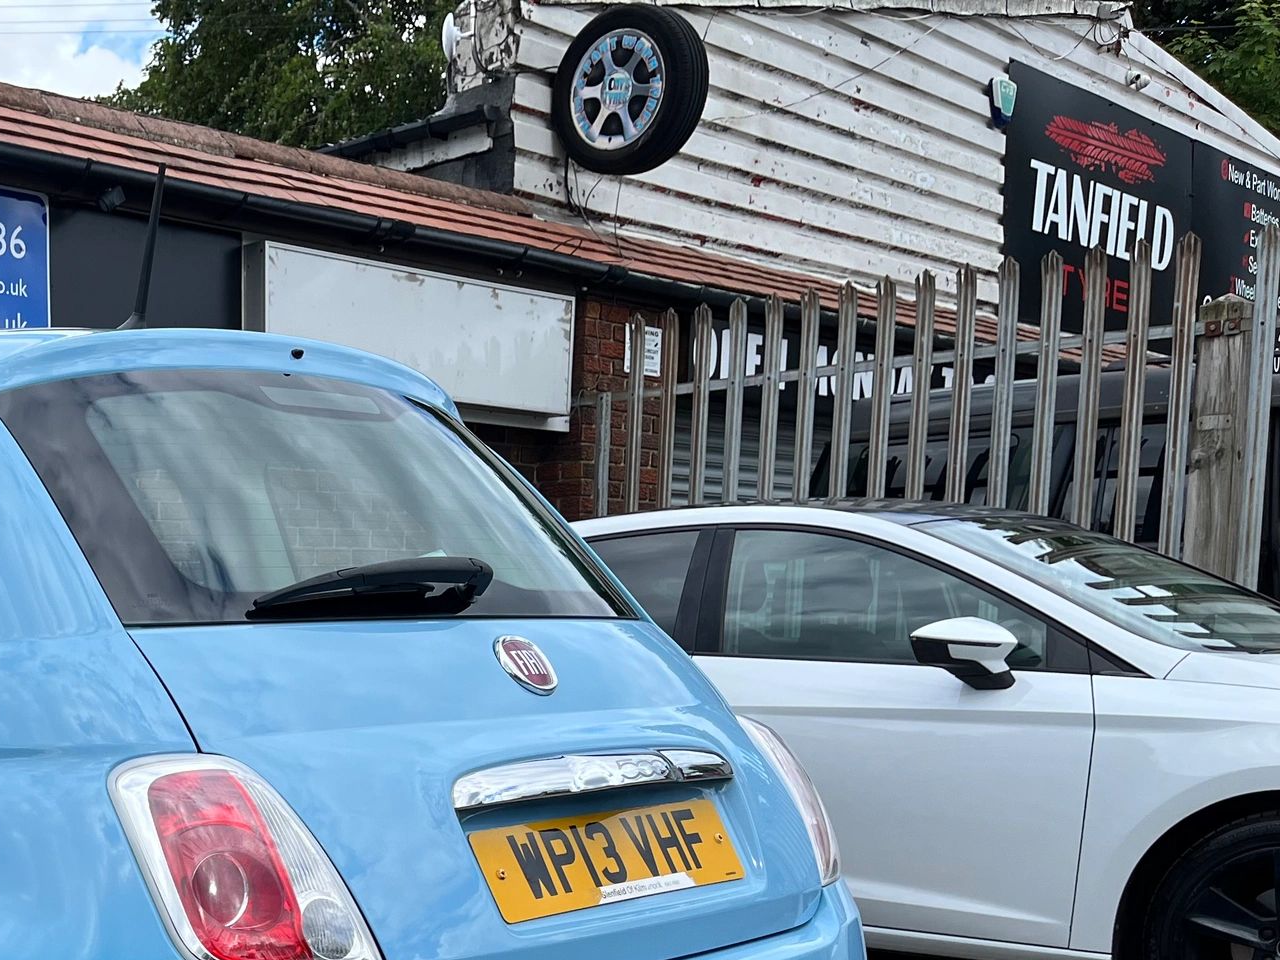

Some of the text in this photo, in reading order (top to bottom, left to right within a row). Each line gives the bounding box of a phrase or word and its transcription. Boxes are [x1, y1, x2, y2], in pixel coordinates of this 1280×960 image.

[1228, 163, 1280, 202] New & Part Wor
[1030, 158, 1174, 271] TANFIELD
[510, 649, 547, 676] FIAT
[616, 759, 669, 779] 500
[506, 808, 702, 899] WP13 VHF
